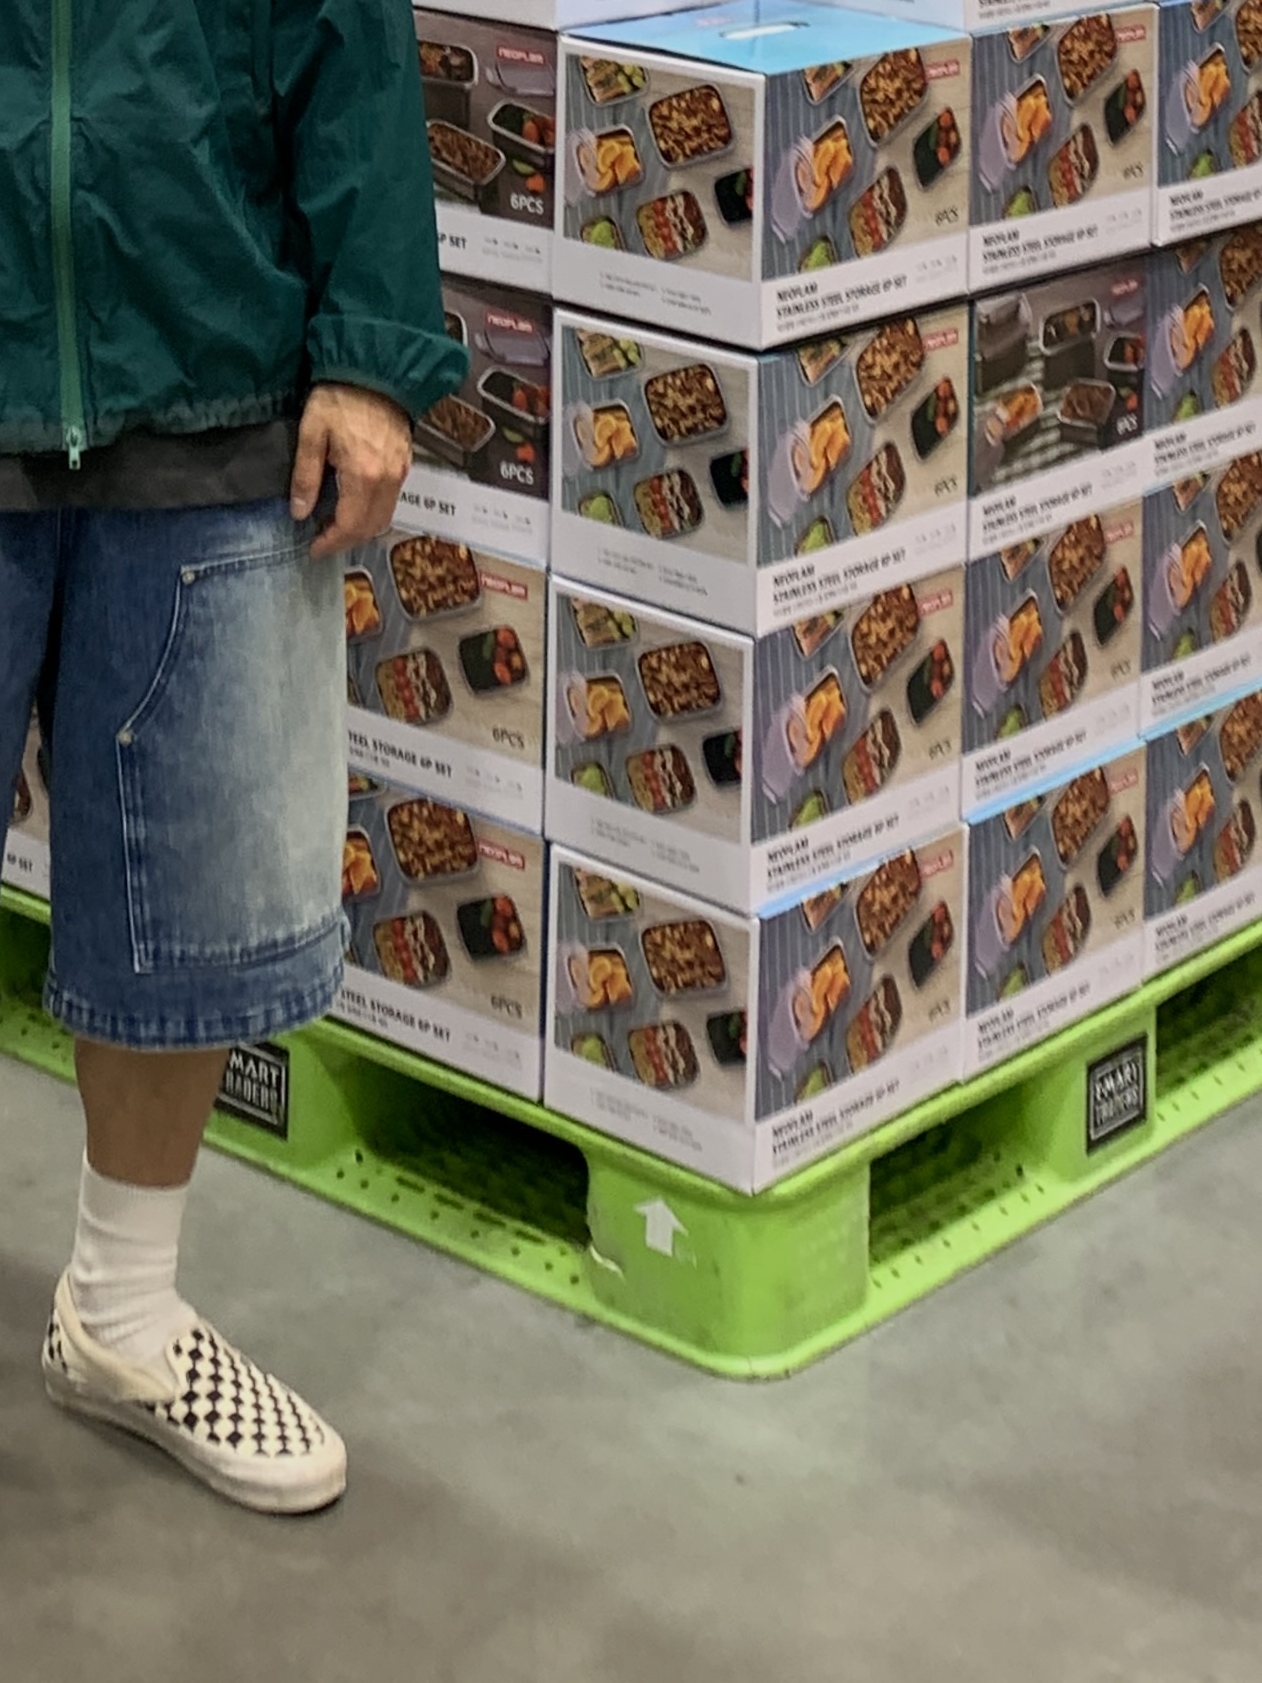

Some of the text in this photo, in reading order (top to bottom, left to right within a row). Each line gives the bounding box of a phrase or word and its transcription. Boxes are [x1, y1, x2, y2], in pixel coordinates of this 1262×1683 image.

[510, 192, 544, 215] 6PCS
[449, 235, 466, 249] SET
[501, 460, 534, 485] 6PCS
[439, 500, 456, 517] SET
[492, 726, 525, 748] 6PCS
[371, 738, 417, 766] STORAGE
[435, 759, 452, 778] SET
[490, 995, 523, 1019] 6PCS
[229, 1049, 279, 1088] MART
